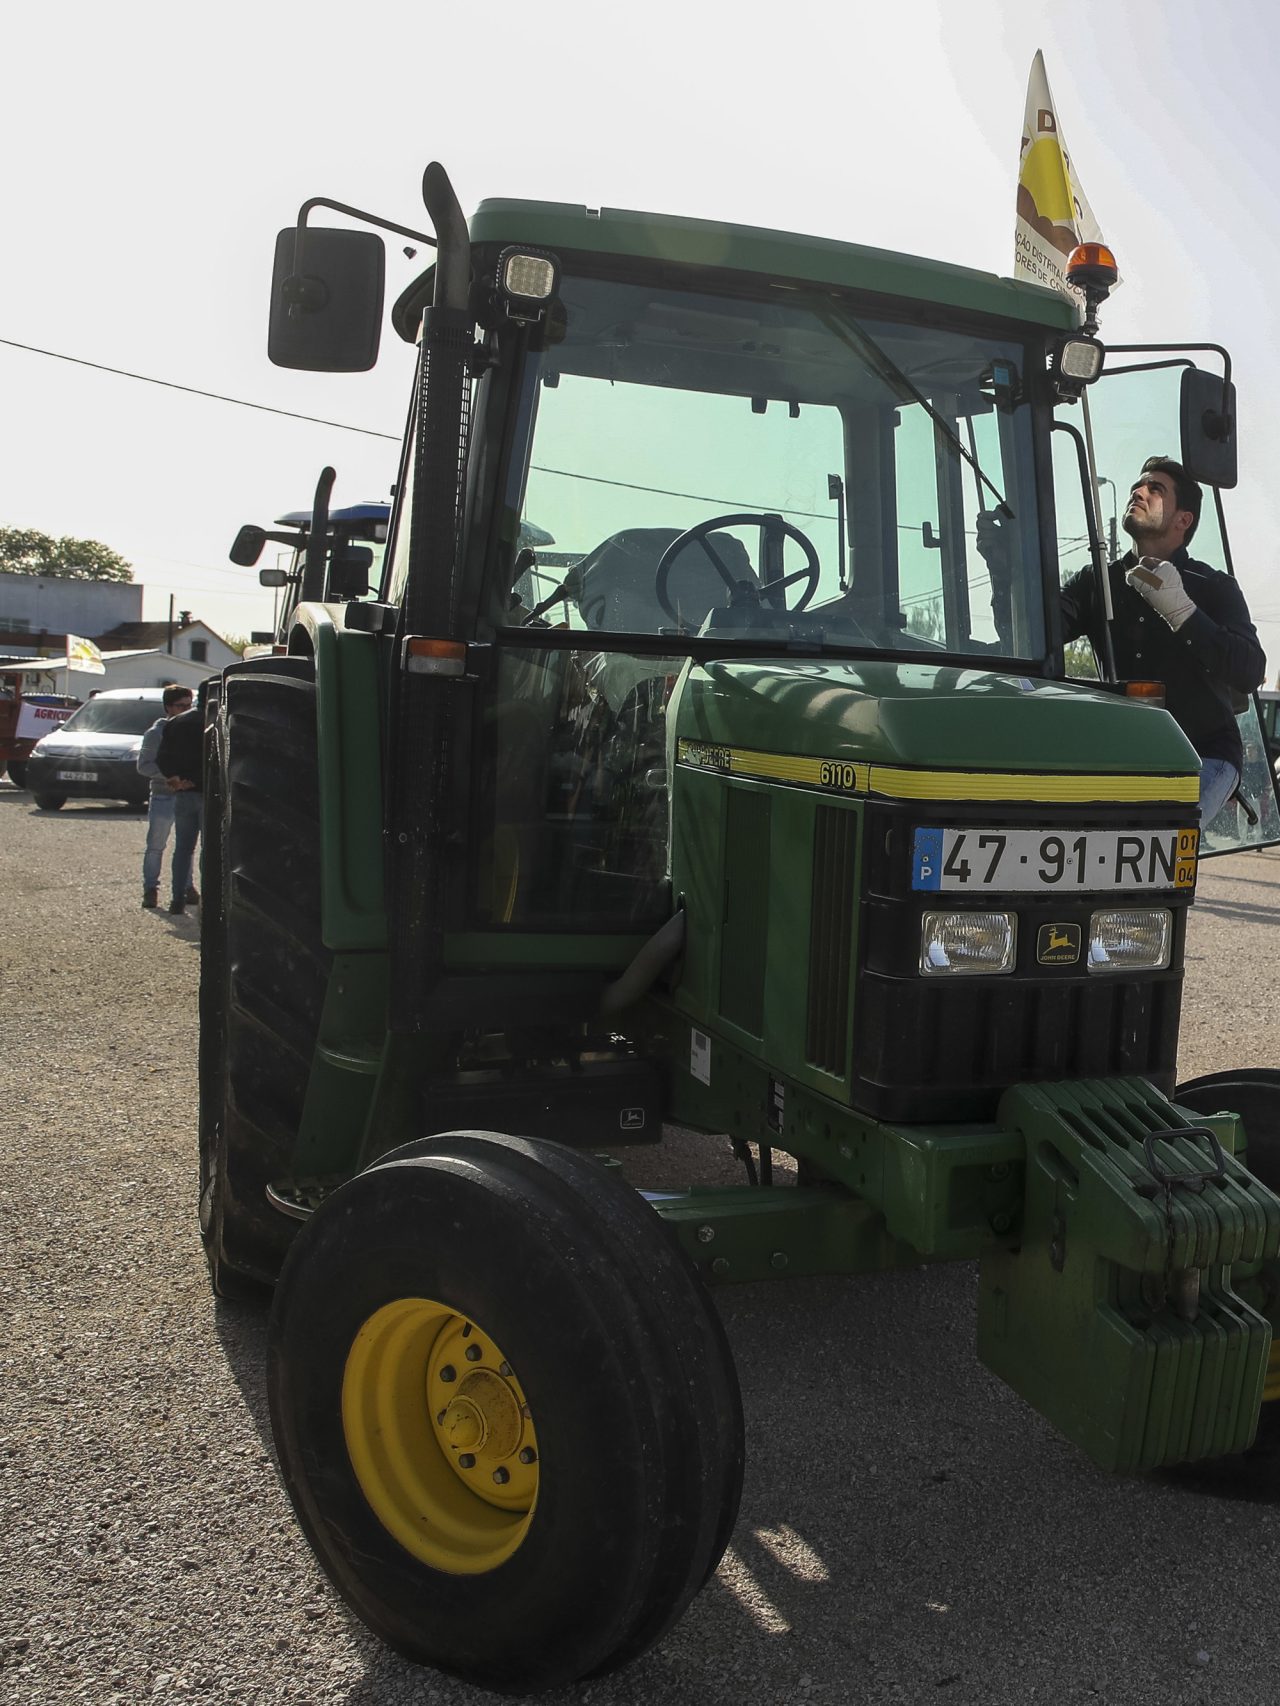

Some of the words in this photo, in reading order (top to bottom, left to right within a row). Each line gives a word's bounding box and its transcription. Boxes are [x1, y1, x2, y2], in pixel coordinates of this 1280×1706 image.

[1015, 231, 1031, 252] ÇÃO
[1032, 246, 1065, 284] DISTRITAL
[1015, 251, 1037, 275] ORES
[1037, 270, 1048, 285] DE
[820, 762, 856, 789] 6110
[1179, 834, 1196, 851] 01
[920, 865, 932, 881] P
[1178, 866, 1193, 883] 04
